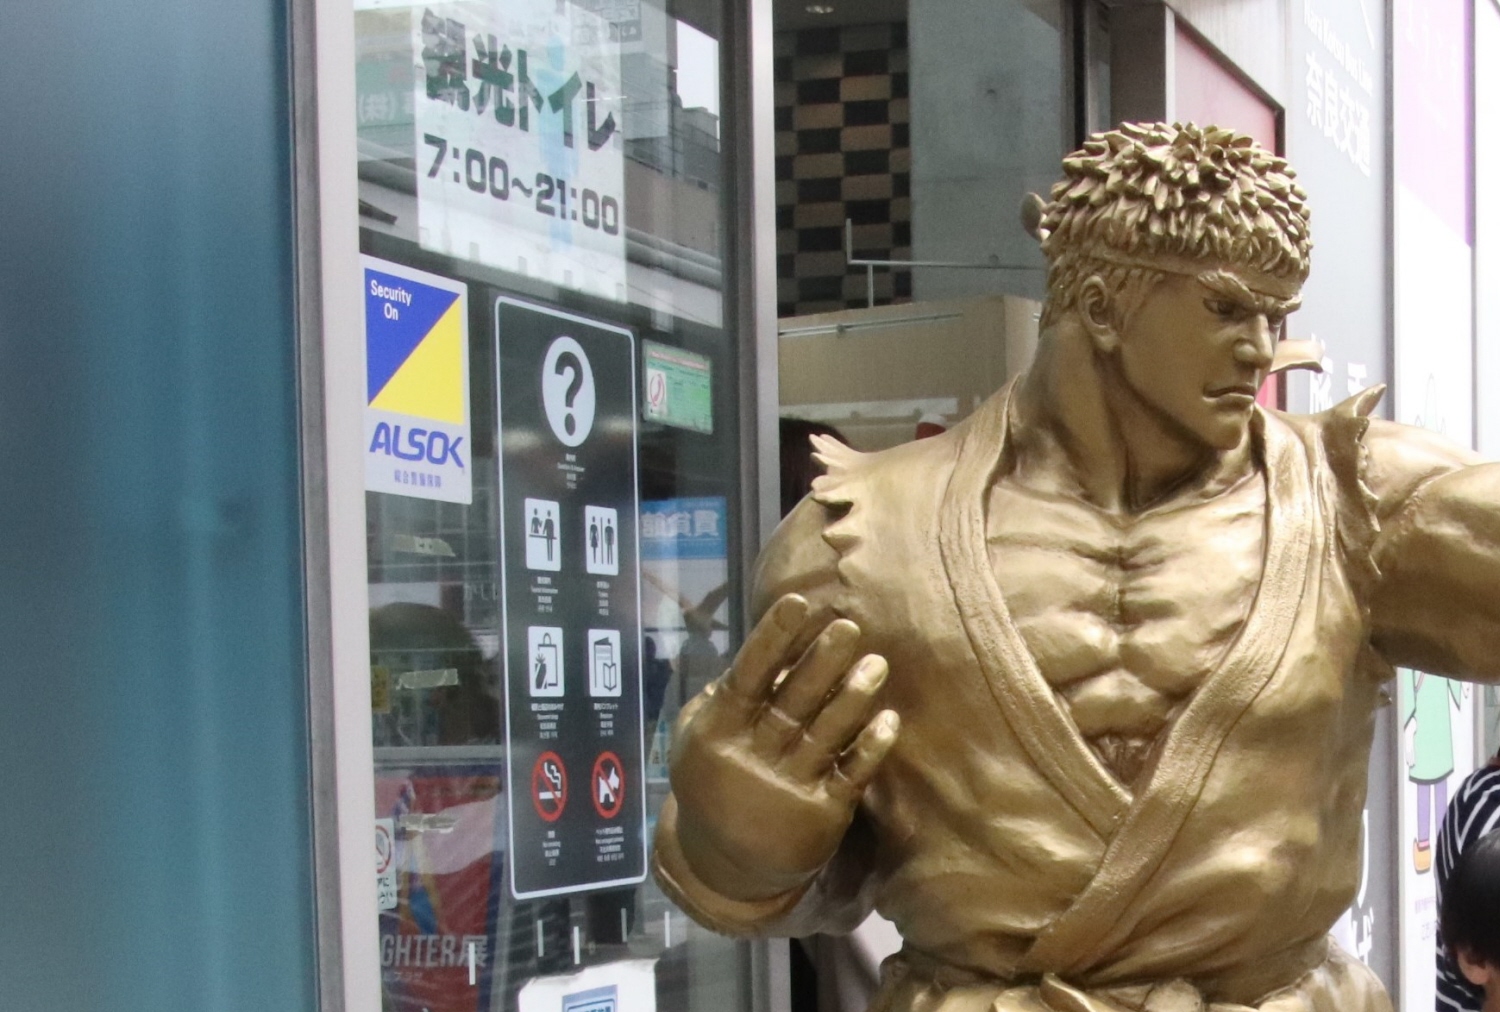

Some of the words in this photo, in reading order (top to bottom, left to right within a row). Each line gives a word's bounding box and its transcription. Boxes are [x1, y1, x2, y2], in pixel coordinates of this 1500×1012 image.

[1305, 50, 1371, 178] 奈良交通
[370, 279, 412, 307] Security
[384, 302, 398, 321] On
[369, 422, 465, 469] ALSOK
